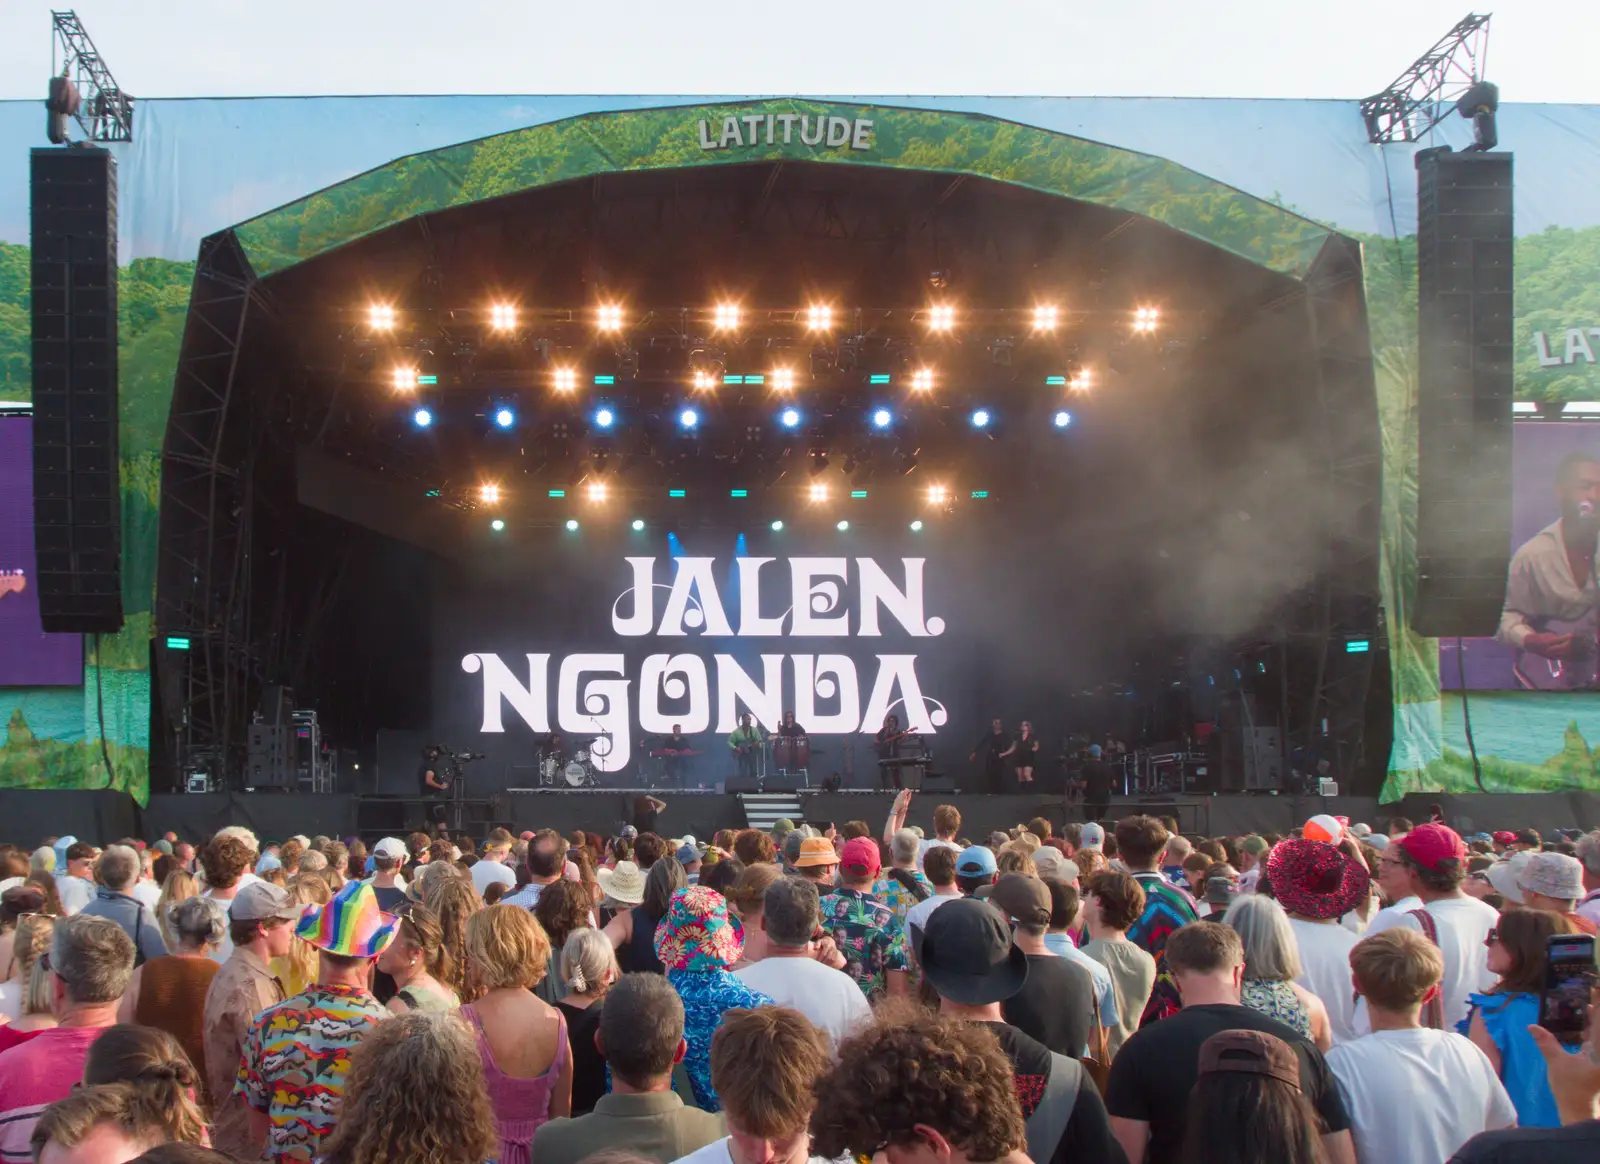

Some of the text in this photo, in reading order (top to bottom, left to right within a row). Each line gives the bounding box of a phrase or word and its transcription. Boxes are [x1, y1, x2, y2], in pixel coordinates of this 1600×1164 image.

[698, 114, 873, 150] LATITUDE
[612, 557, 945, 637] JALEN
[462, 653, 947, 772] NGONDA
